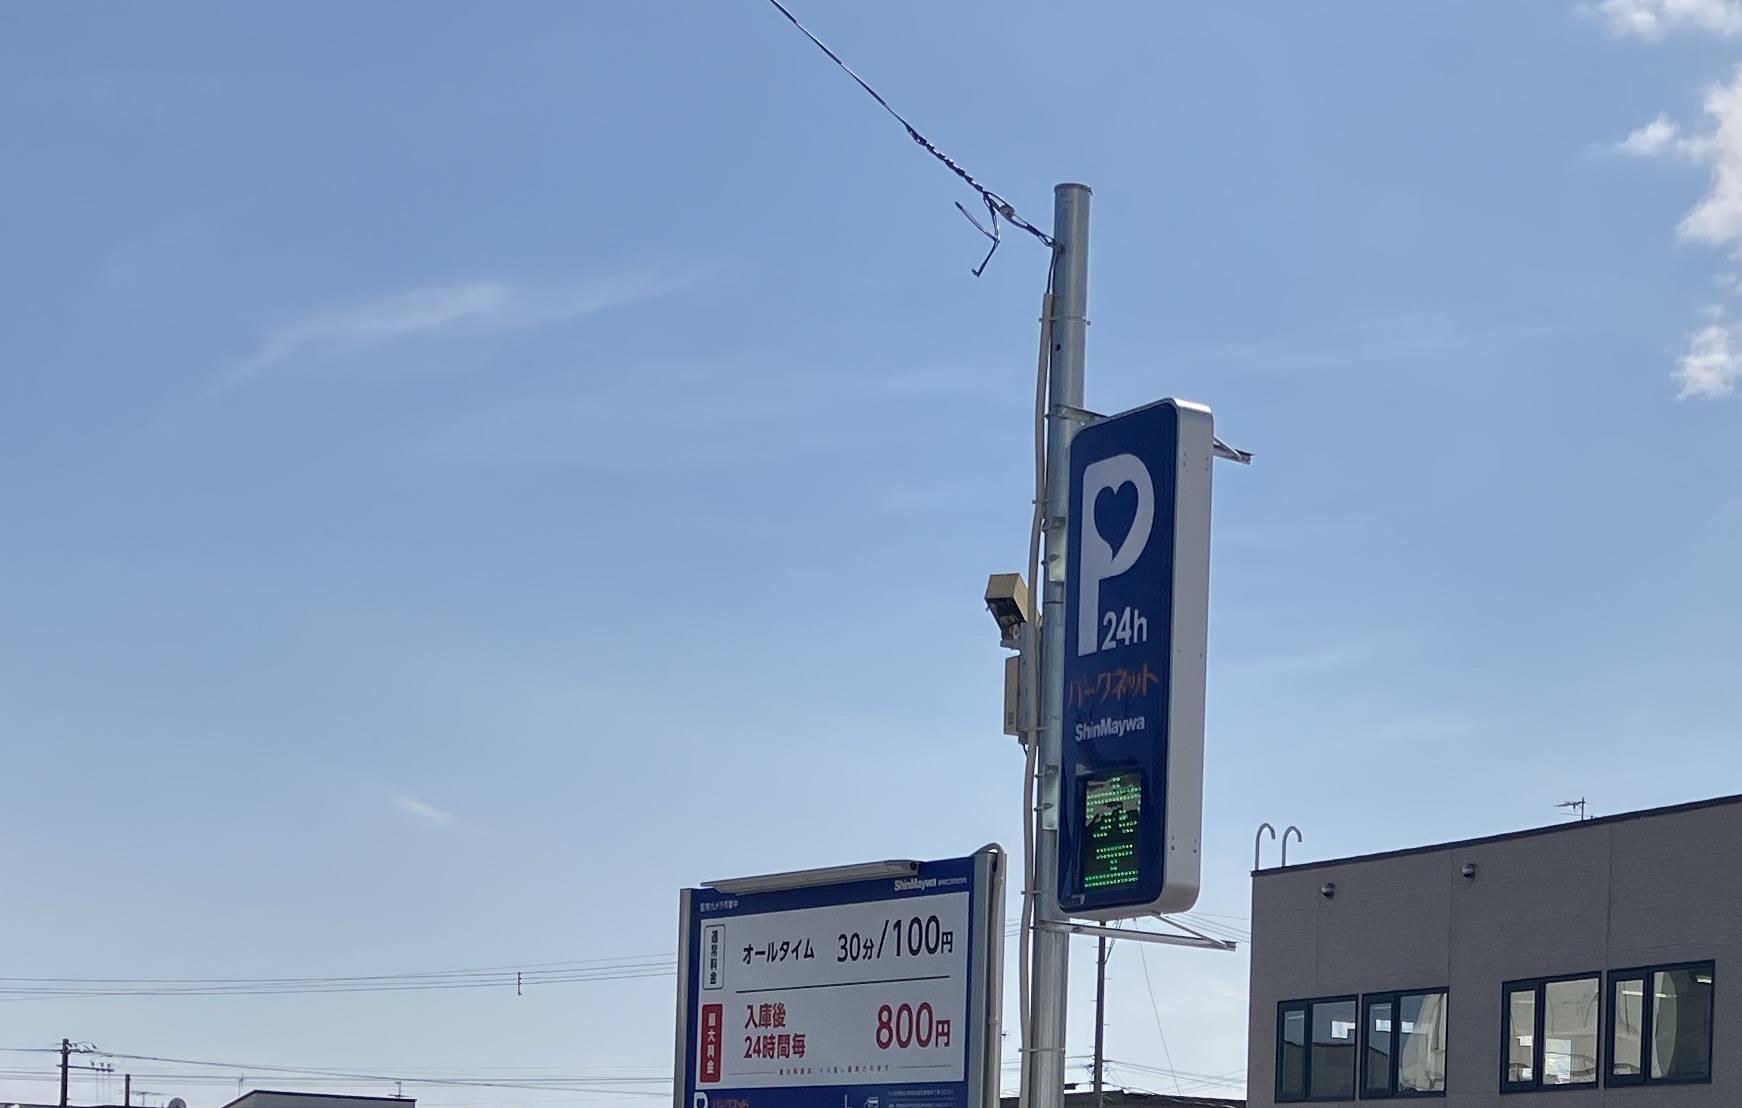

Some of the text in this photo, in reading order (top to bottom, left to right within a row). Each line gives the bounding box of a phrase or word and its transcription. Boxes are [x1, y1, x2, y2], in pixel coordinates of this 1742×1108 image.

[1101, 606, 1148, 651] 24h
[1075, 716, 1145, 742] ShinMaywa
[743, 938, 815, 965] オールタイム
[744, 1002, 787, 1030] 入庫後
[875, 1001, 951, 1050] 800円
[743, 1033, 806, 1059] 24時間毎
